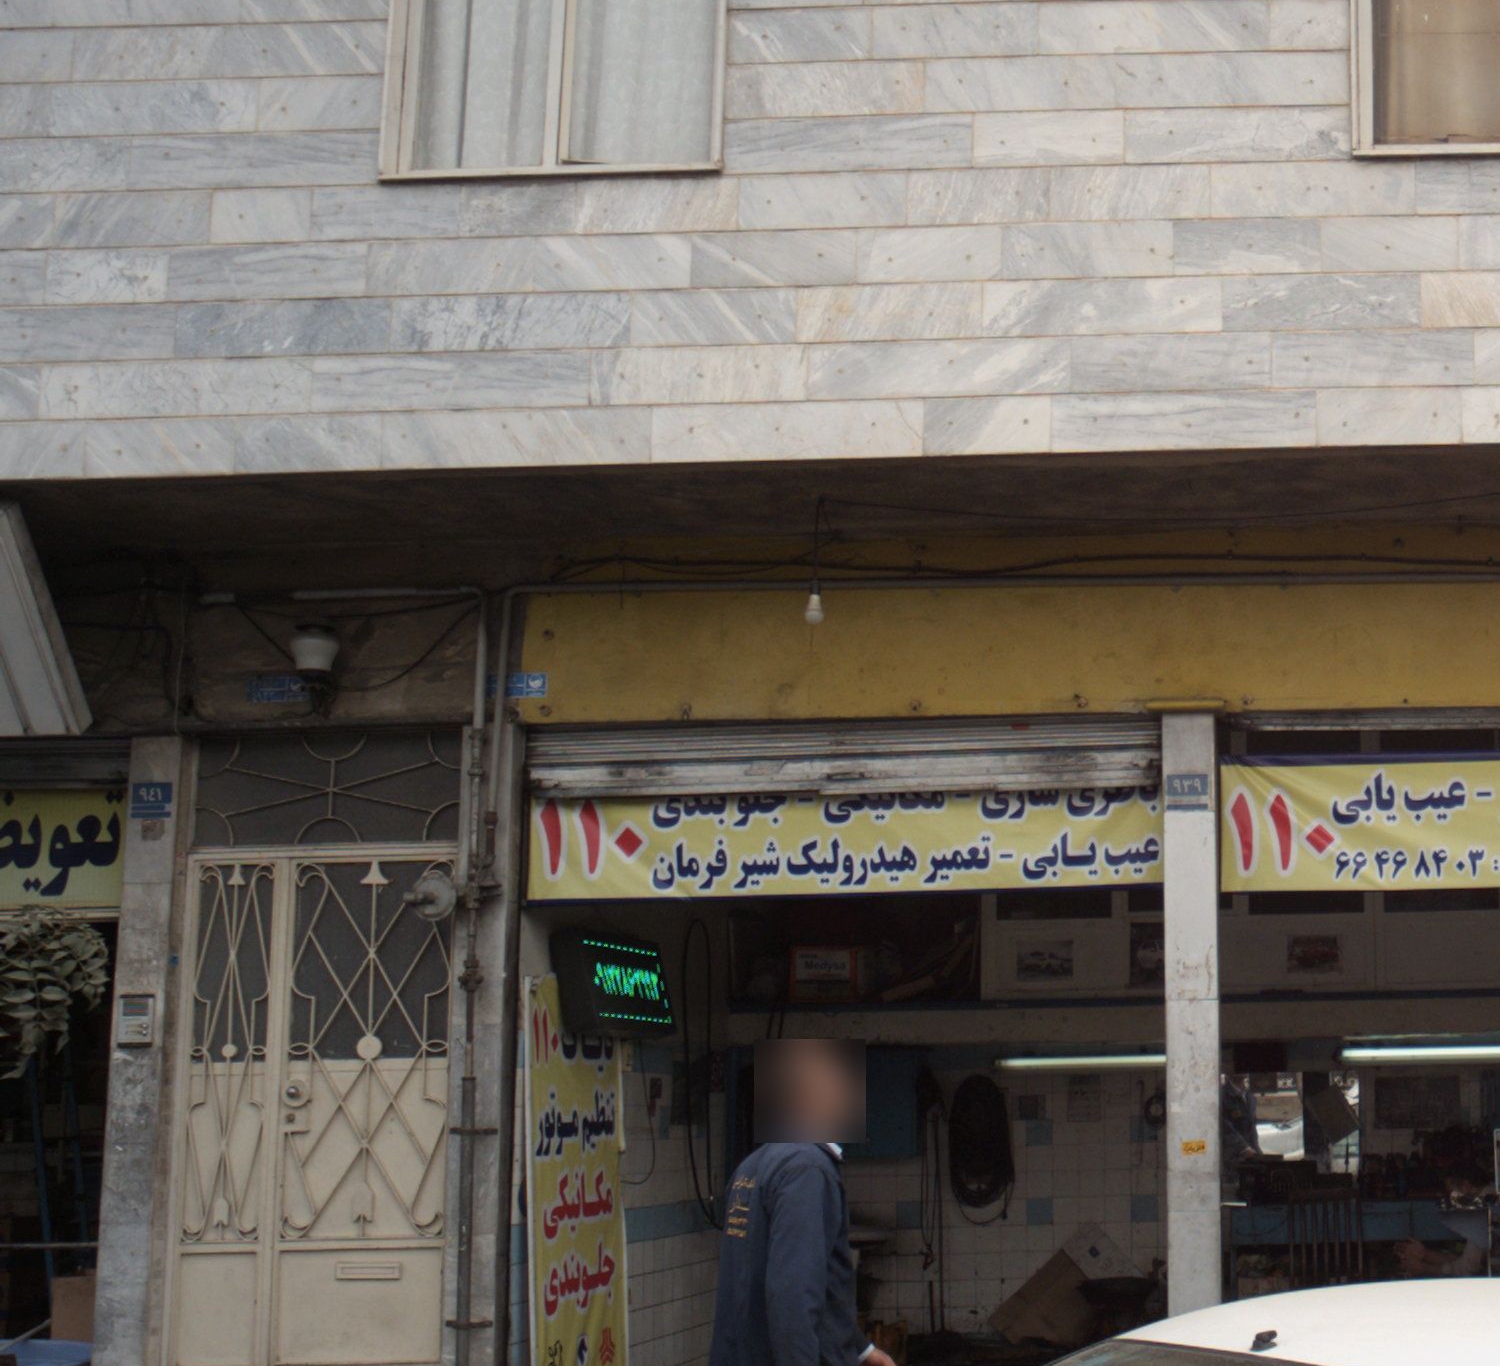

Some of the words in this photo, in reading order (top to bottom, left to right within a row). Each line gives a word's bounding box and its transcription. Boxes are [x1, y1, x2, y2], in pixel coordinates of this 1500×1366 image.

[1172, 777, 1202, 794] ۹۳۹
[1331, 772, 1397, 825] یابی
[1403, 780, 1467, 822] عیب
[539, 798, 644, 876] ۱۱۰
[1022, 831, 1098, 880] یابی
[1103, 836, 1161, 875] عیب
[1230, 792, 1336, 872] ۱۱۰
[652, 838, 728, 890] فرمان
[733, 840, 781, 889] شیر
[786, 836, 918, 886] هیدرولیک
[922, 835, 992, 884] تعمیر
[535, 1091, 579, 1157] موتور
[581, 1089, 616, 1153] تنظیم
[543, 1170, 614, 1240] مکانیکی
